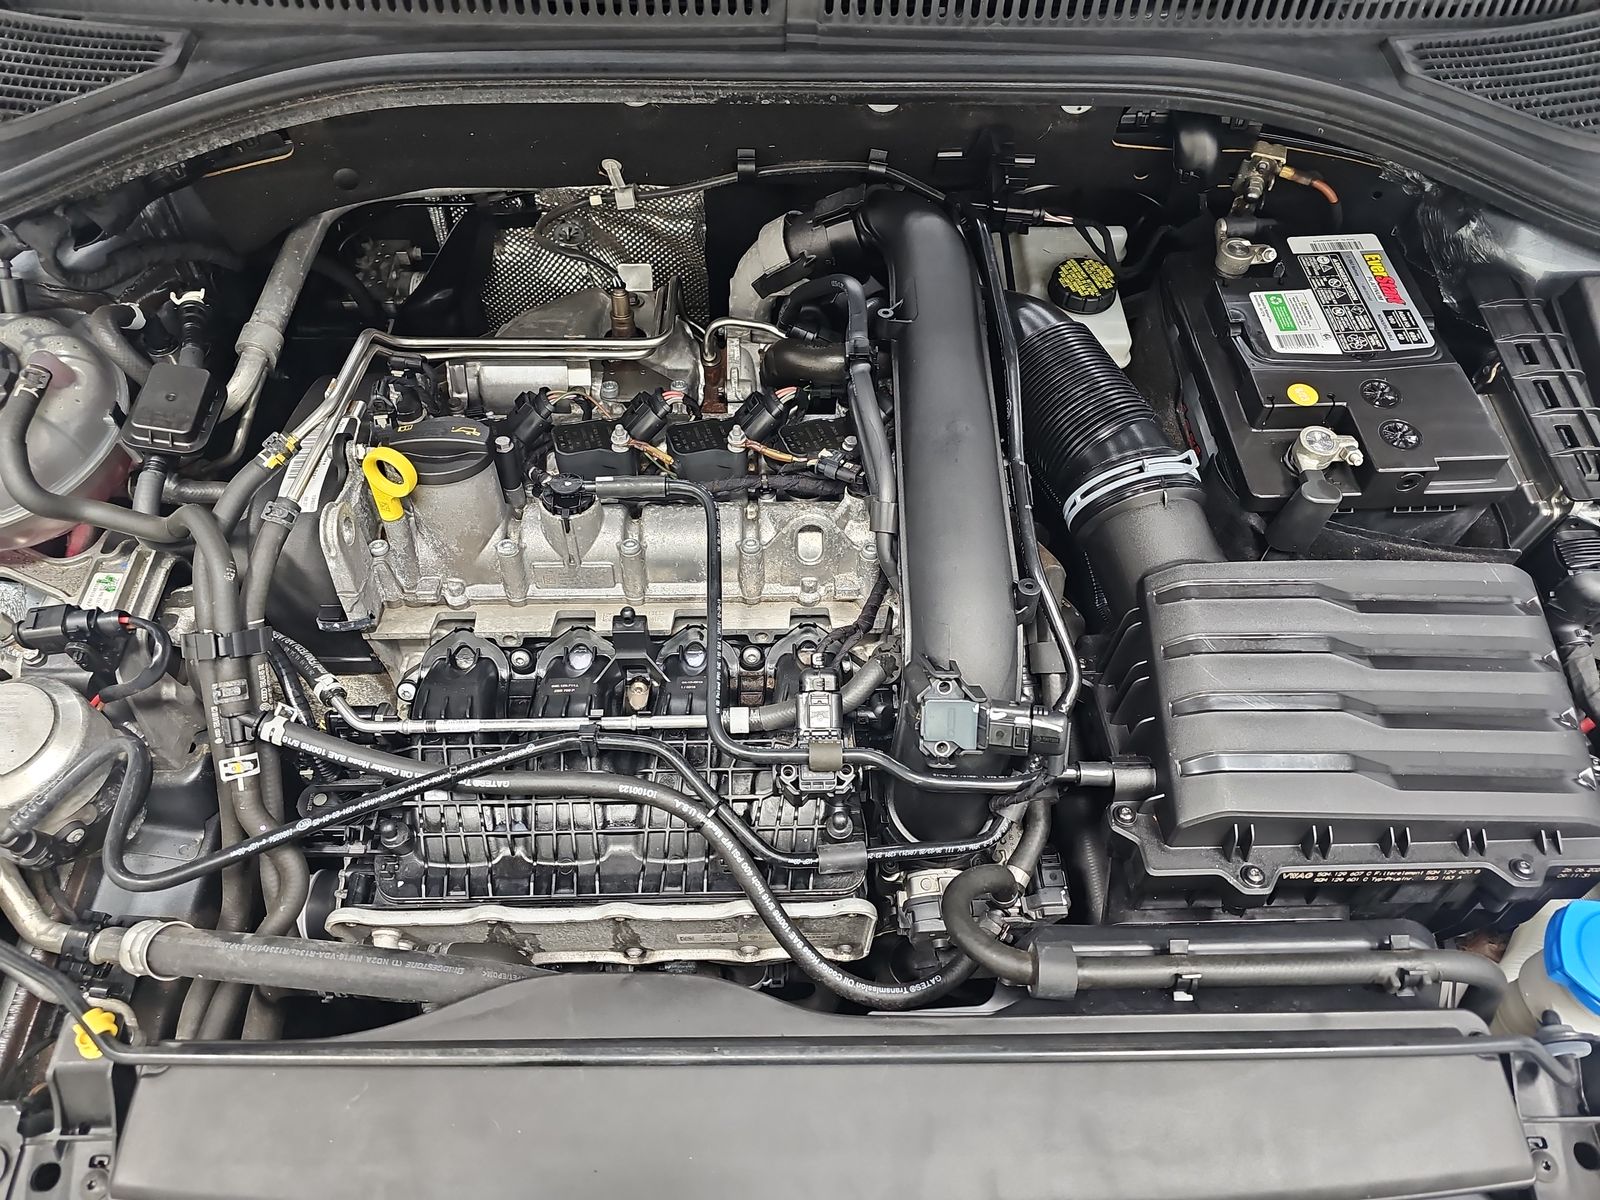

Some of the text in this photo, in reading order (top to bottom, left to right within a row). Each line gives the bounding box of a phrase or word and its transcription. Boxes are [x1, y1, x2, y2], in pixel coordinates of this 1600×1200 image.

[1362, 253, 1407, 304] EverStart
[1367, 276, 1384, 302] PLATINUM
[327, 751, 347, 763] SAE
[347, 756, 371, 769] Hose
[370, 761, 400, 777] Cooler
[400, 769, 413, 779] Oil
[720, 836, 735, 853] WP
[731, 850, 745, 864] PSI
[742, 862, 754, 878] 400
[789, 930, 804, 949] SAE
[802, 947, 820, 966] Hose
[405, 962, 465, 975] BRIDGESTONE
[819, 960, 843, 981] Cooler
[841, 975, 856, 988] Oil
[855, 981, 909, 994] Transmission
